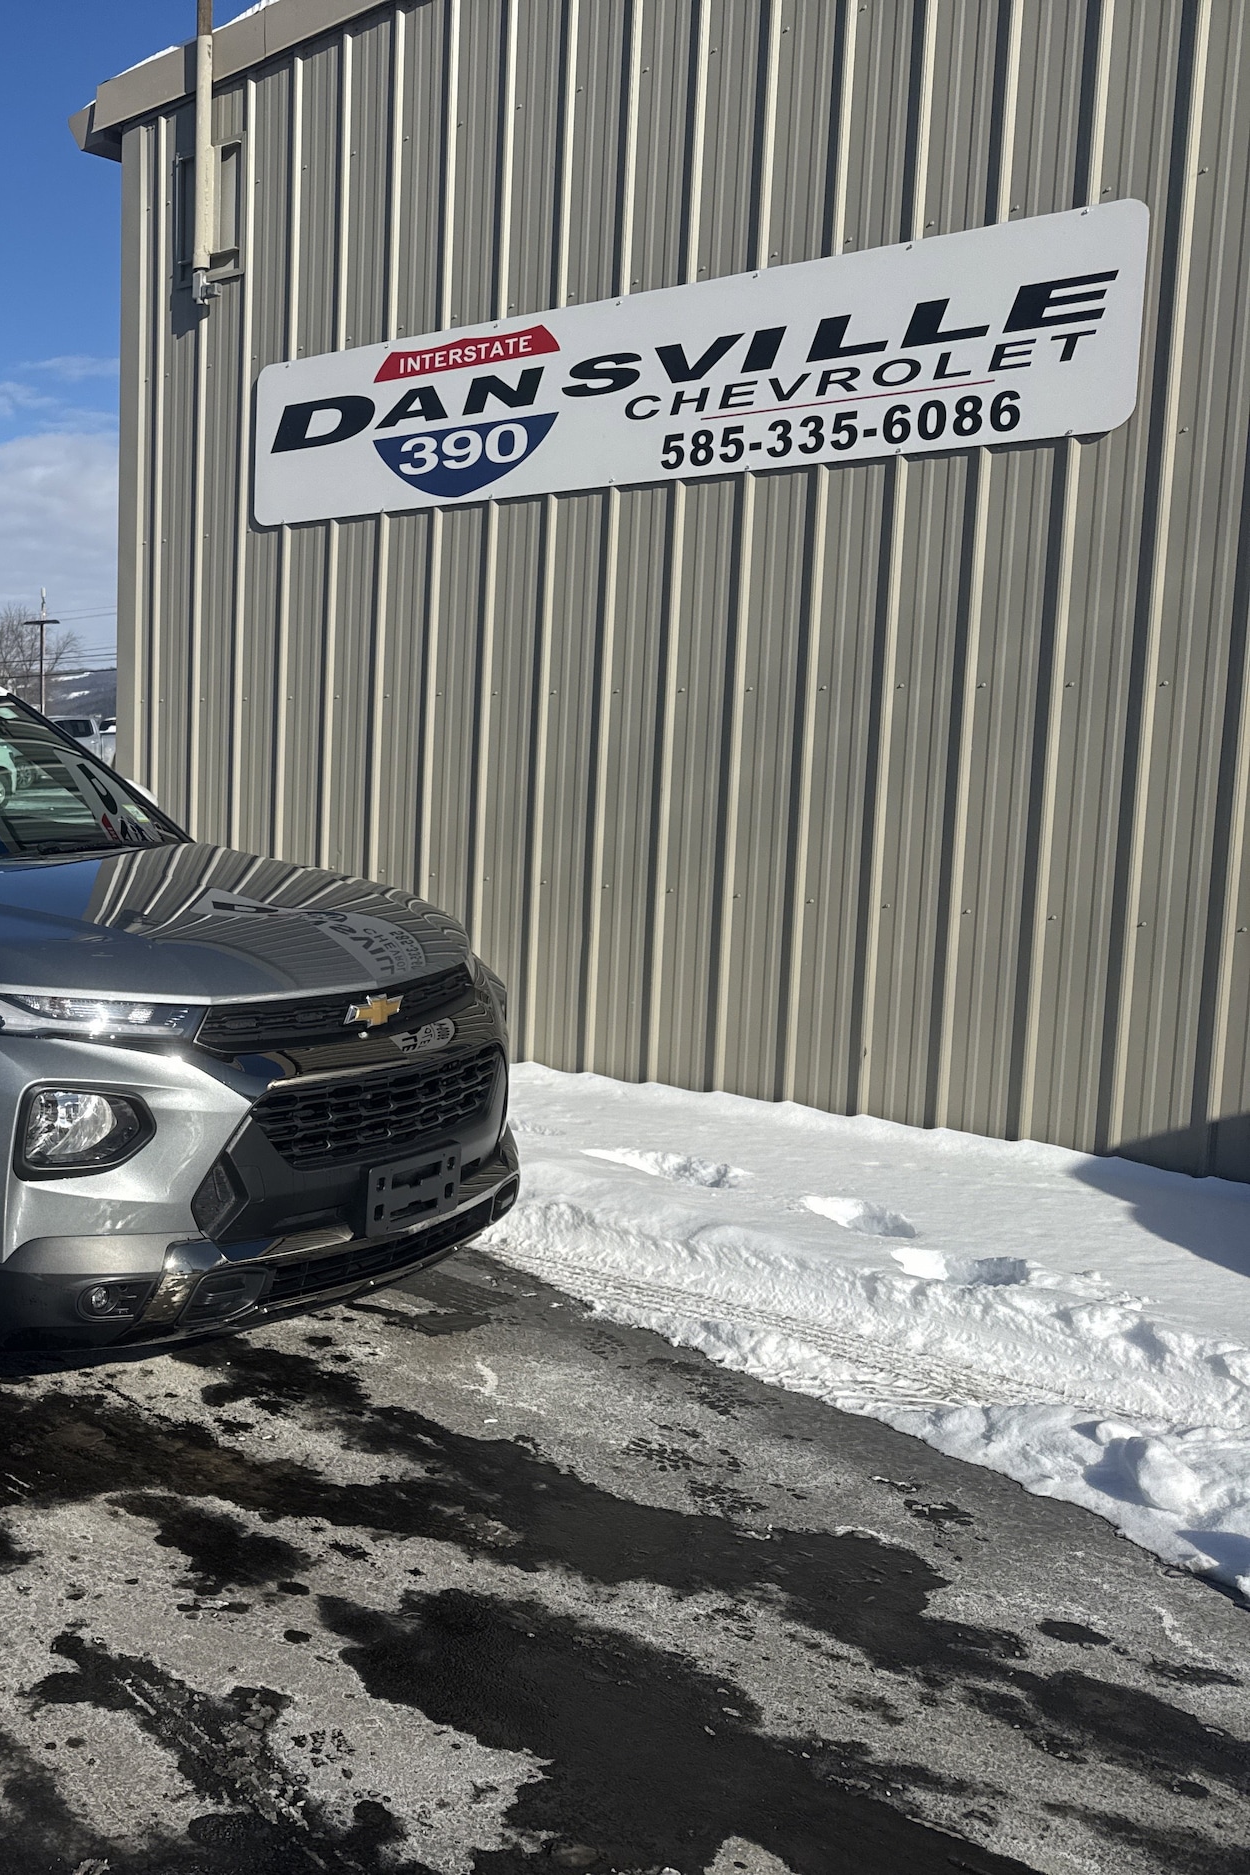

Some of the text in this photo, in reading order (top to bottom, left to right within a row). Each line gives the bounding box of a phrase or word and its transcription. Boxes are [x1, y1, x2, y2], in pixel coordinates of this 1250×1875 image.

[270, 269, 1120, 454] DANSVILLE
[398, 334, 533, 375] INTERSTATE
[624, 329, 1098, 421] CHEVROLET
[398, 422, 530, 476] 390
[660, 389, 1022, 470] 585-335-6086
